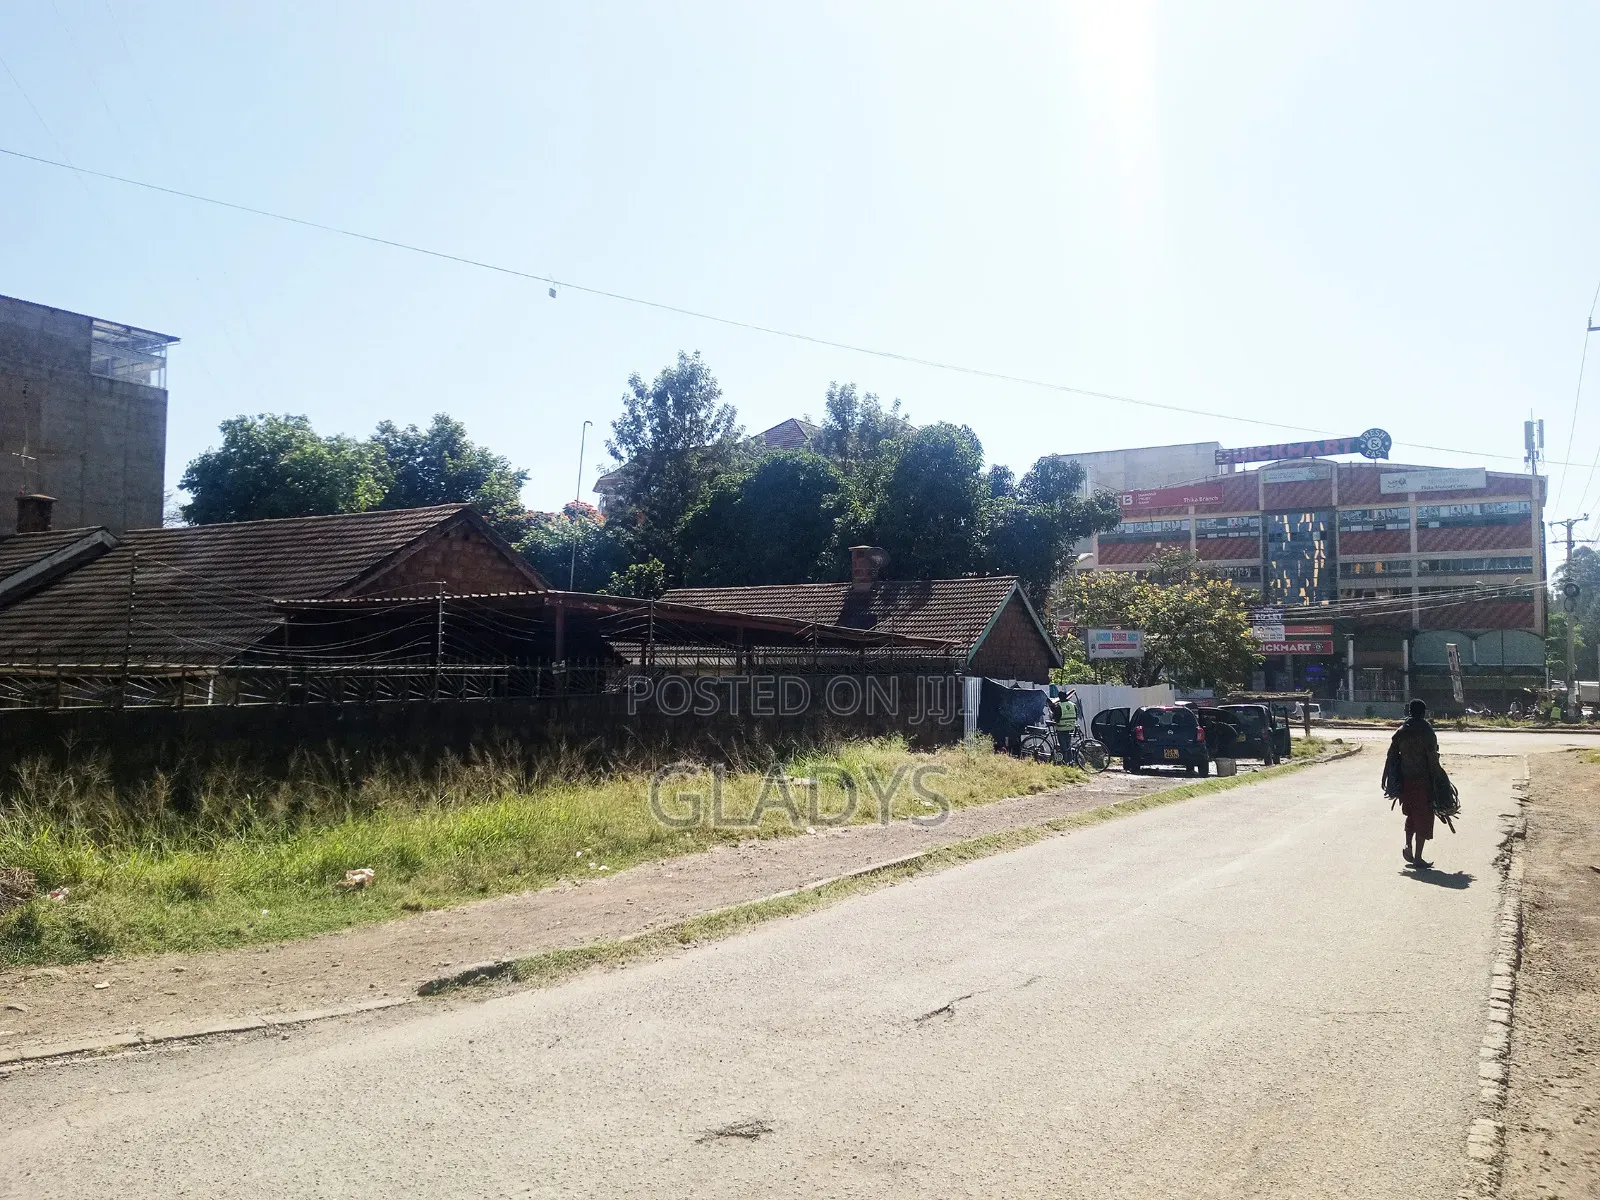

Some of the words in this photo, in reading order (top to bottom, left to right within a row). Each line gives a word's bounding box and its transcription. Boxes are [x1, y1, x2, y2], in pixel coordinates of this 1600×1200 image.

[1360, 430, 1387, 443] FRESH
[1365, 447, 1387, 458] EASY
[1258, 643, 1311, 652] ICKMART
